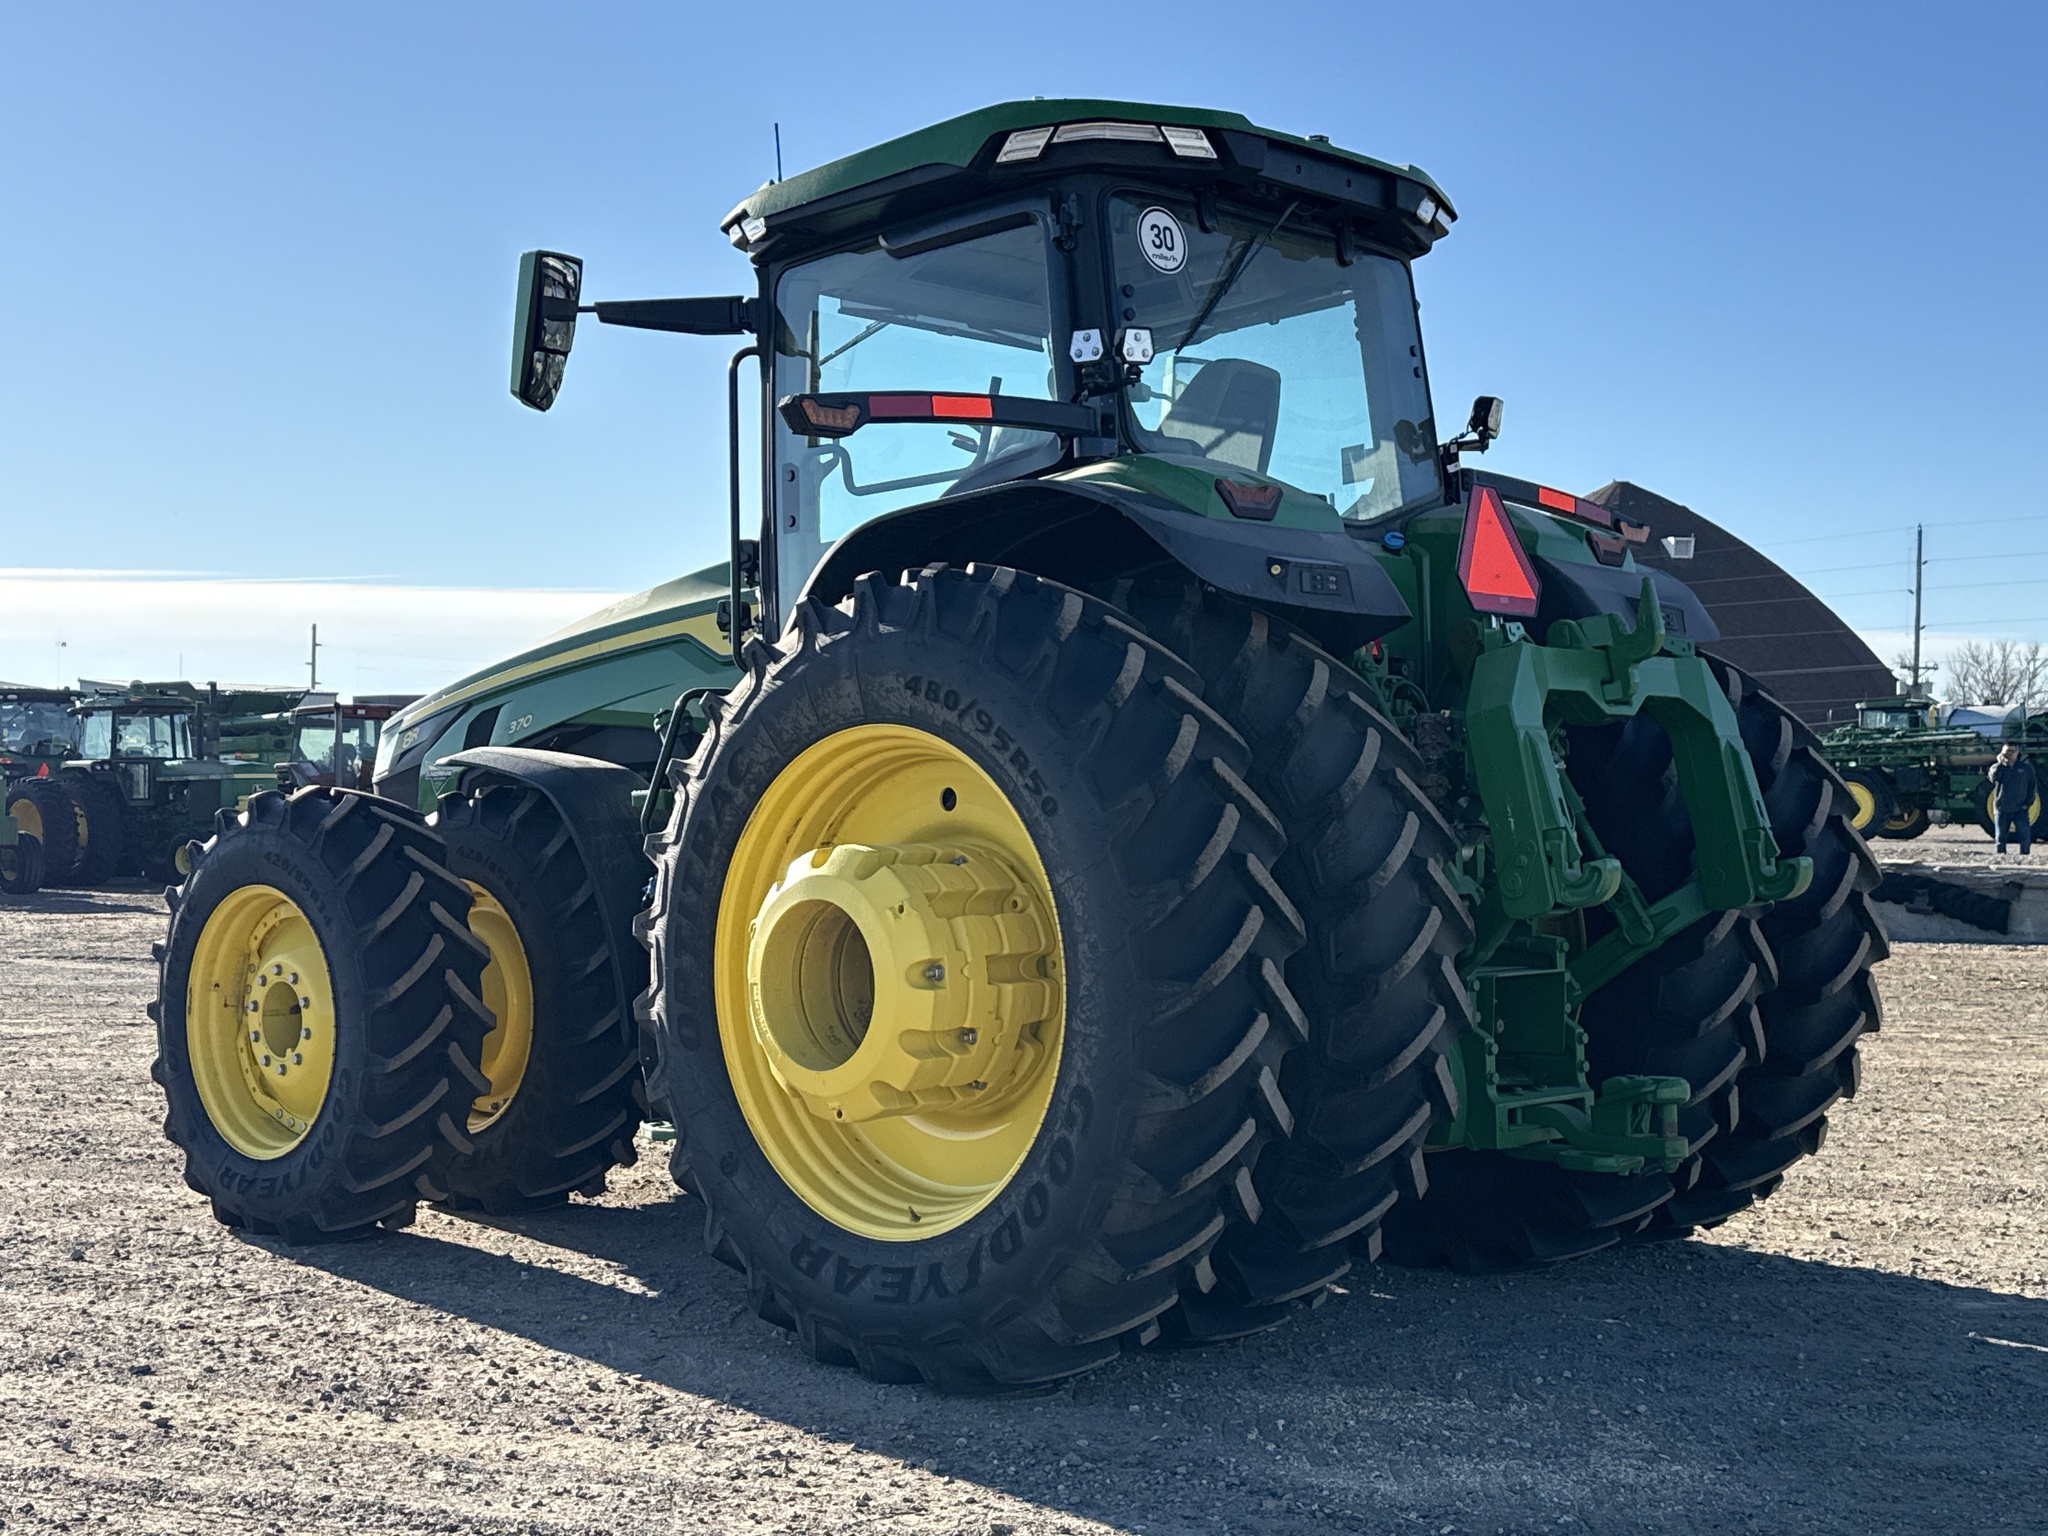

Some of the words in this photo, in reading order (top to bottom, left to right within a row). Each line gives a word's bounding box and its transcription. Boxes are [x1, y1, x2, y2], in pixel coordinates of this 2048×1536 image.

[1150, 223, 1174, 251] 30
[402, 727, 420, 749] 8R
[508, 714, 533, 735] 370
[904, 675, 1059, 817] 480/95R50
[219, 1068, 352, 1199] GOODYEAR
[789, 1085, 1094, 1303] GOODYEAR
